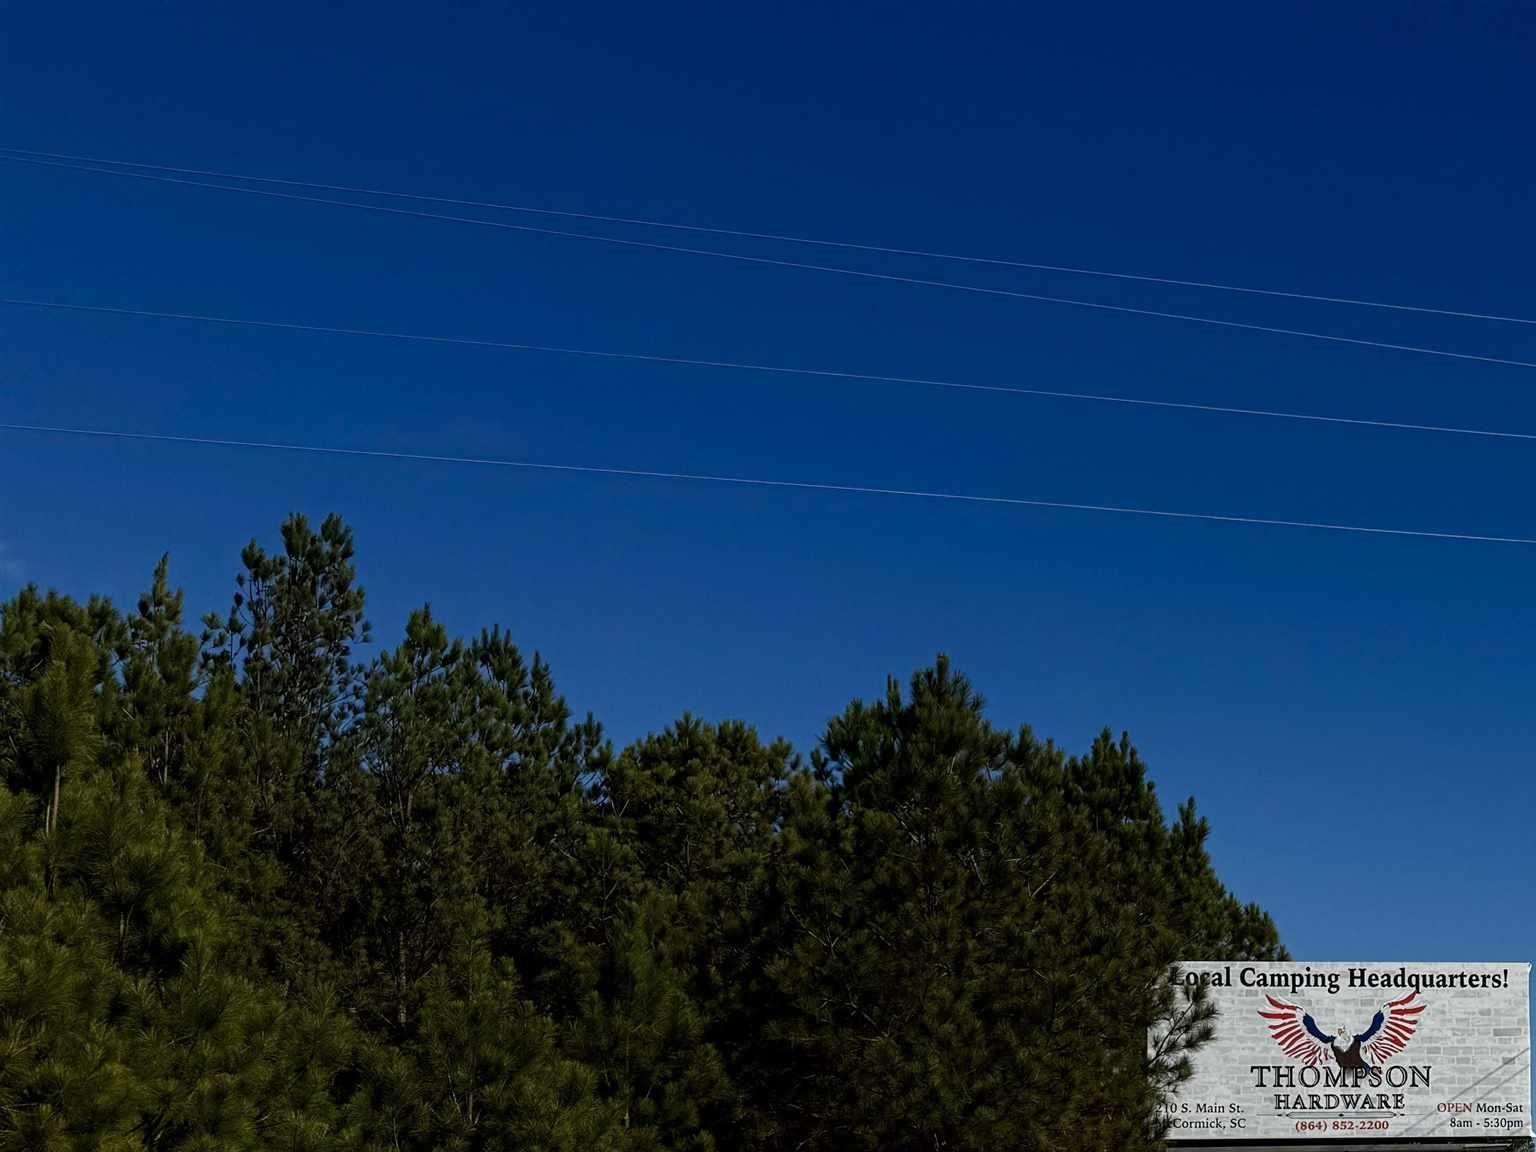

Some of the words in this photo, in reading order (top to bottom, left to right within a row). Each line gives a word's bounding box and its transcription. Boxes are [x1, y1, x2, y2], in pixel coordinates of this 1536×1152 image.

[1240, 966, 1340, 994] Camping
[1348, 967, 1508, 994] Headquarters!
[1250, 1065, 1432, 1088] THOMPSON
[1181, 1103, 1192, 1113] S.
[1196, 1102, 1225, 1113] Main
[1229, 1103, 1244, 1113] St.
[1274, 1094, 1405, 1110] HARDWARE
[1437, 1102, 1472, 1113] OPEN
[1476, 1102, 1523, 1113] Mon-Sat
[1156, 1117, 1226, 1130] Cormick,
[1230, 1118, 1247, 1128] SC
[1295, 1120, 1328, 1132] (864)
[1332, 1120, 1389, 1131] 852-2200
[1449, 1117, 1473, 1128] 8am
[1483, 1117, 1523, 1131] 5:30pm
